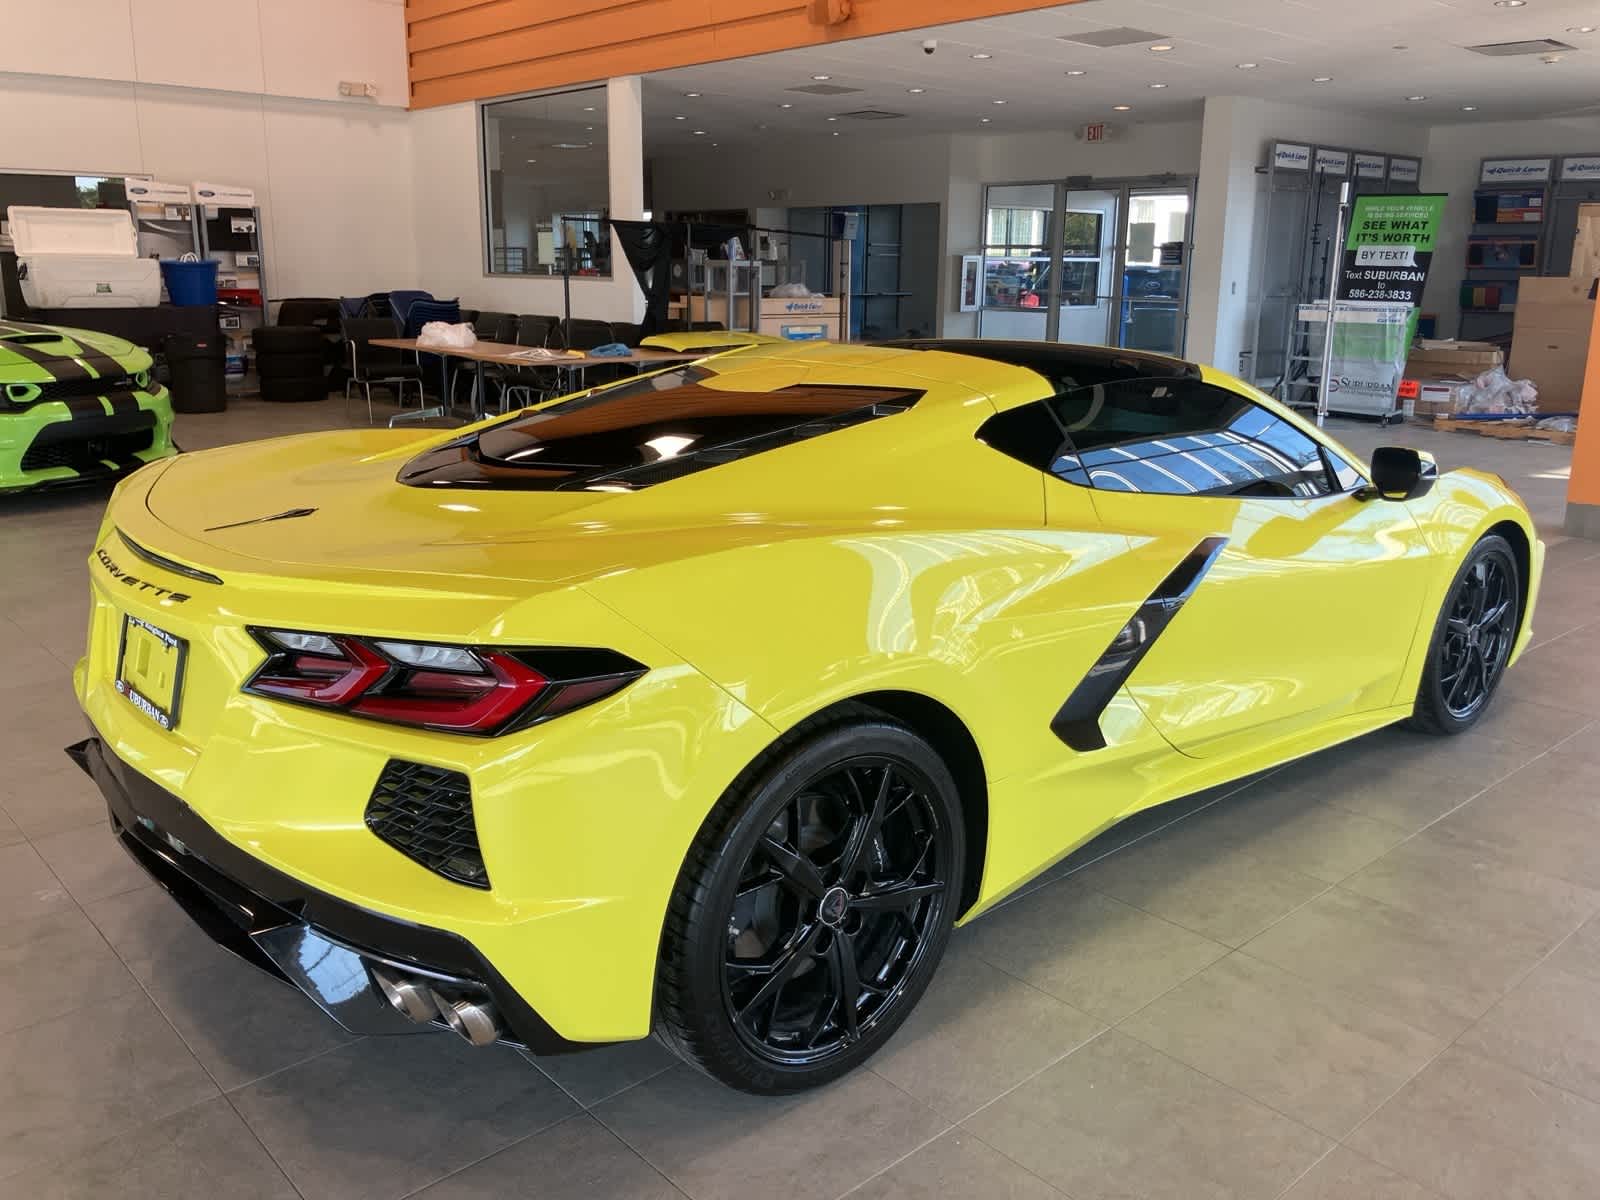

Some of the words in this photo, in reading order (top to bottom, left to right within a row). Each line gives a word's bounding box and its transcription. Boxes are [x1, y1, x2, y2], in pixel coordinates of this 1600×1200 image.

[1088, 124, 1105, 141] EXIT
[1362, 220, 1387, 230] SEE
[1391, 221, 1429, 230] WHAT
[1356, 233, 1378, 242] IT'S
[1383, 233, 1431, 243] WORTH
[1361, 251, 1376, 260] BY
[1379, 251, 1409, 260] TEXT!
[1345, 270, 1362, 279] Text
[1364, 270, 1425, 282] SUBURBAN
[1377, 281, 1386, 289] to
[1348, 288, 1412, 300] 586-238-3833
[97, 549, 191, 603] CORVETTE
